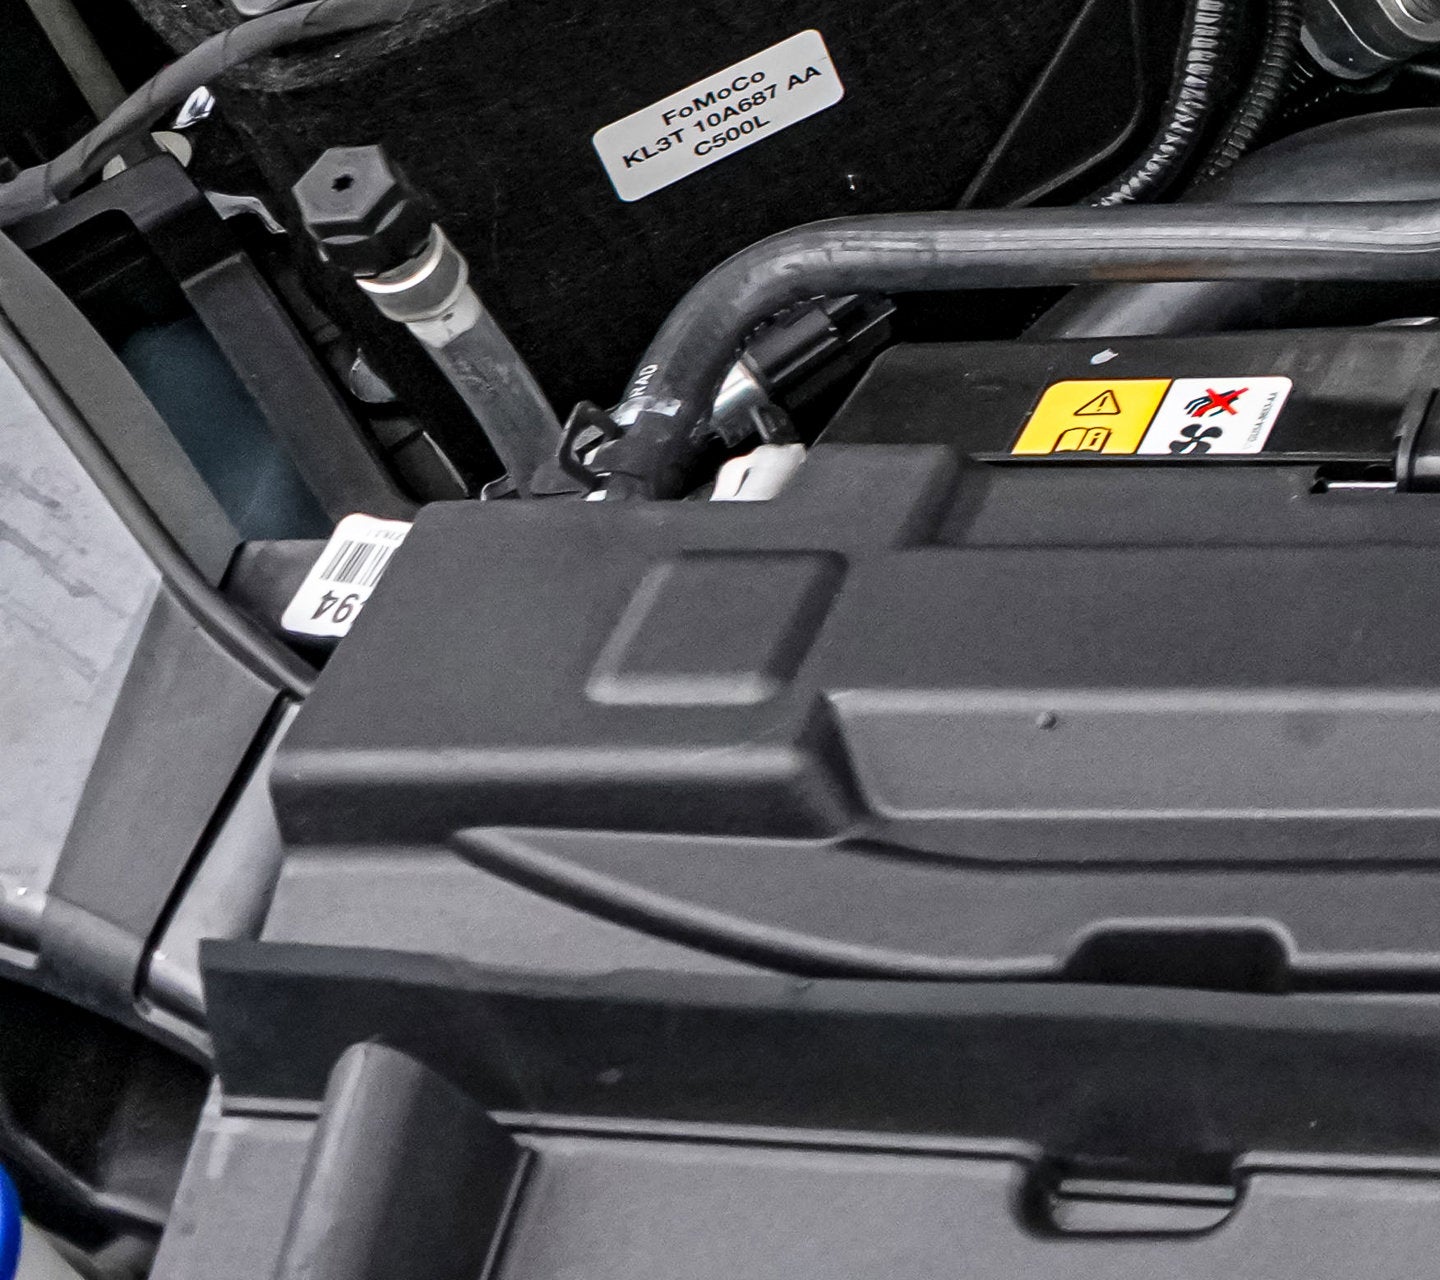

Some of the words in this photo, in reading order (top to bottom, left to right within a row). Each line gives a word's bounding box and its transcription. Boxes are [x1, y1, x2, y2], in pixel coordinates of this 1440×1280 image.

[622, 127, 685, 169] KL3T
[694, 83, 778, 133] 10A687
[786, 65, 822, 91] AA
[661, 71, 766, 126] FoMoCo
[693, 115, 771, 157] C500L
